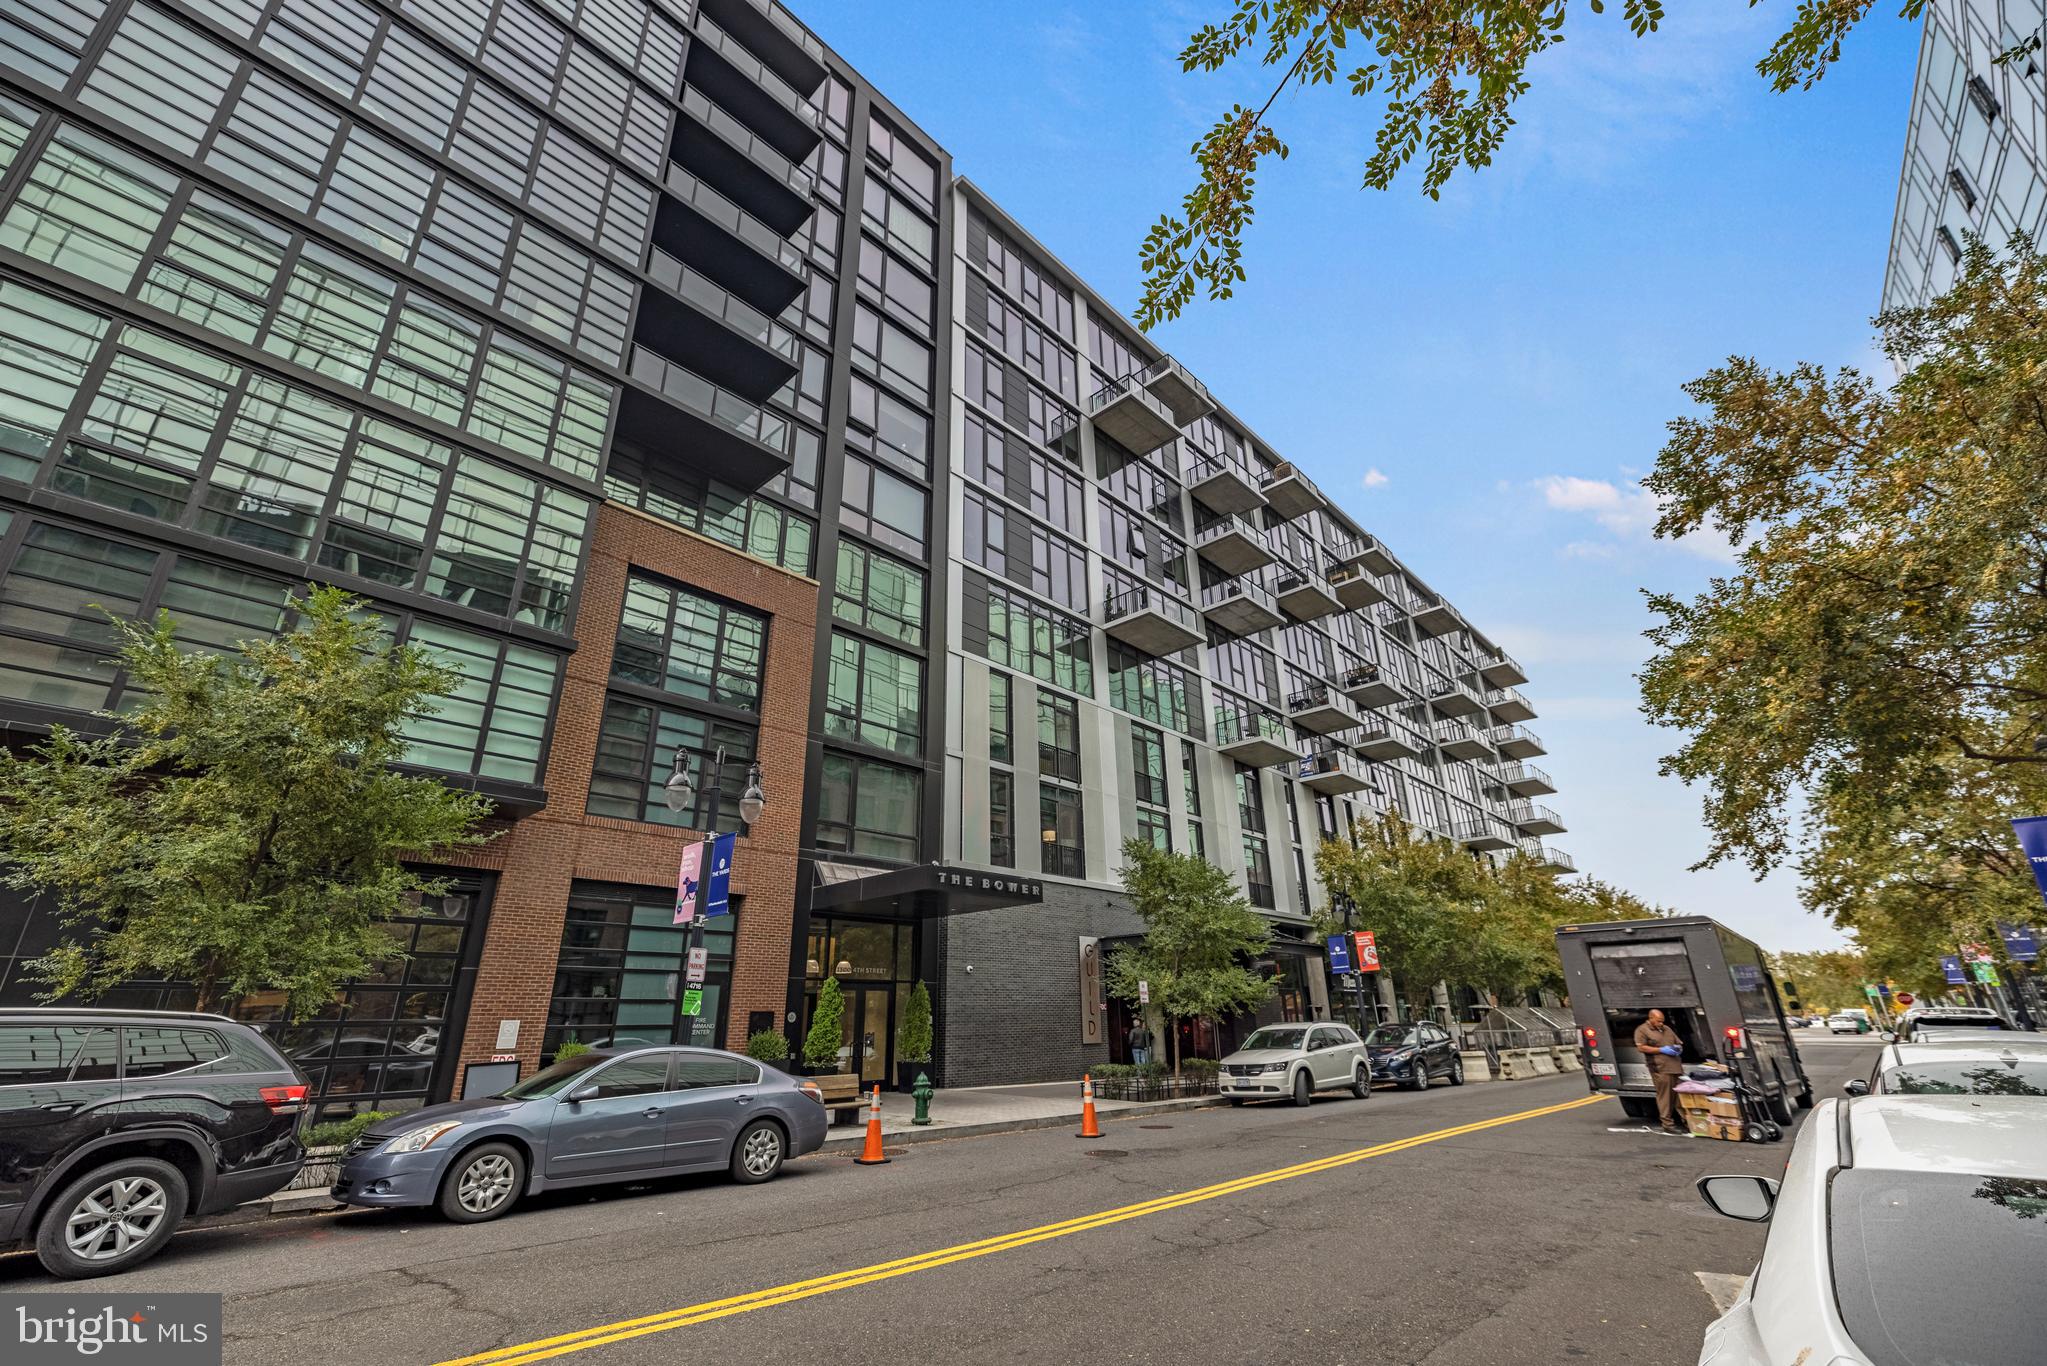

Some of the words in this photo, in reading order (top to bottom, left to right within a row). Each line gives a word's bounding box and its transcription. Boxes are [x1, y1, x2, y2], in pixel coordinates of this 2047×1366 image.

[938, 872, 973, 887] THE
[982, 878, 1040, 896] BOWER
[1084, 944, 1096, 1036] GUILD
